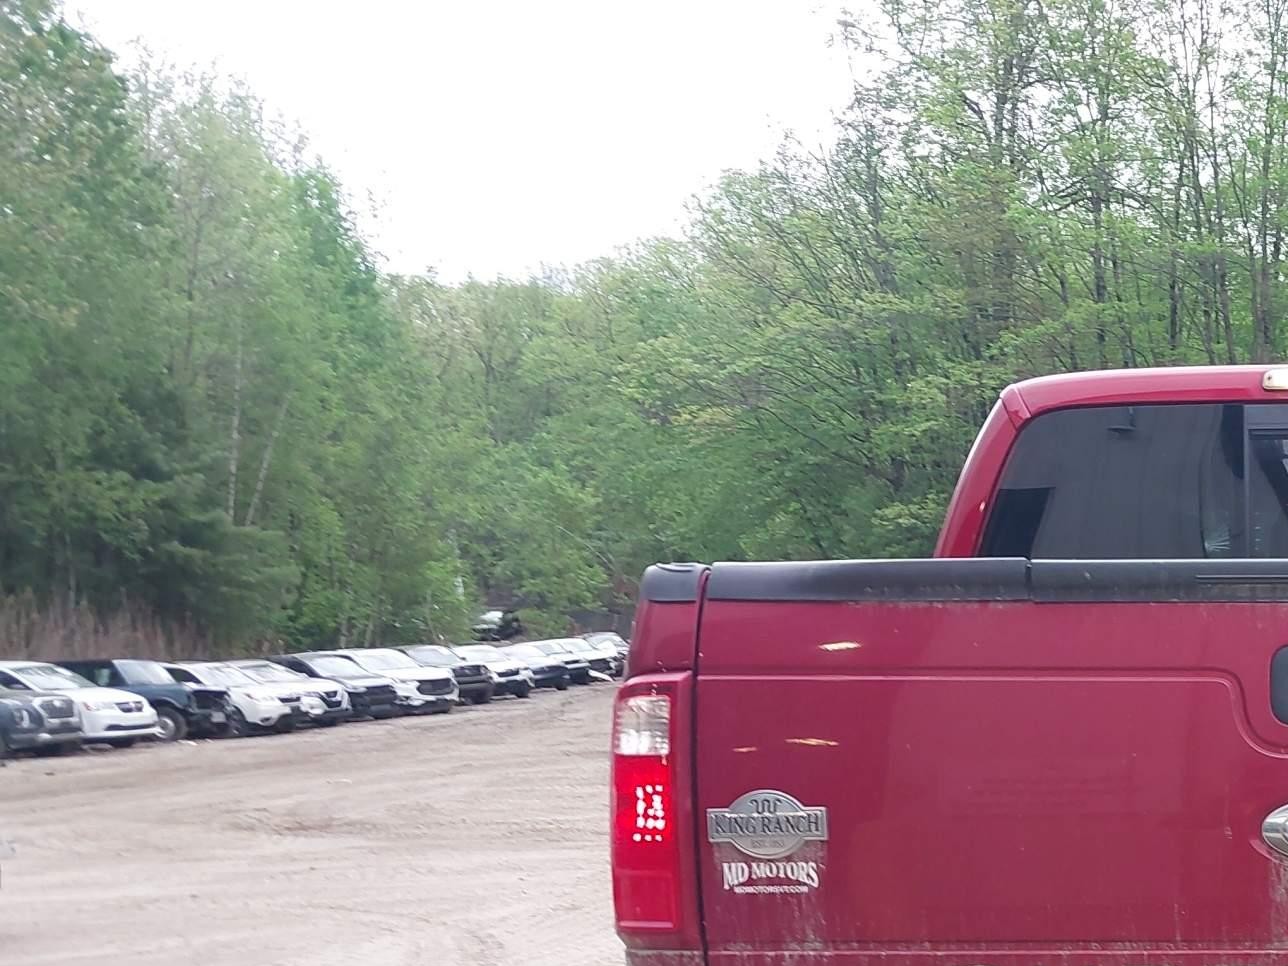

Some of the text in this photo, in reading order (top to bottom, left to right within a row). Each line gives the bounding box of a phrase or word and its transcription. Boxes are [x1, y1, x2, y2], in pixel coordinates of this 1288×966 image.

[711, 813, 820, 834] KING RANCH
[722, 861, 820, 890] MD MOTORS
